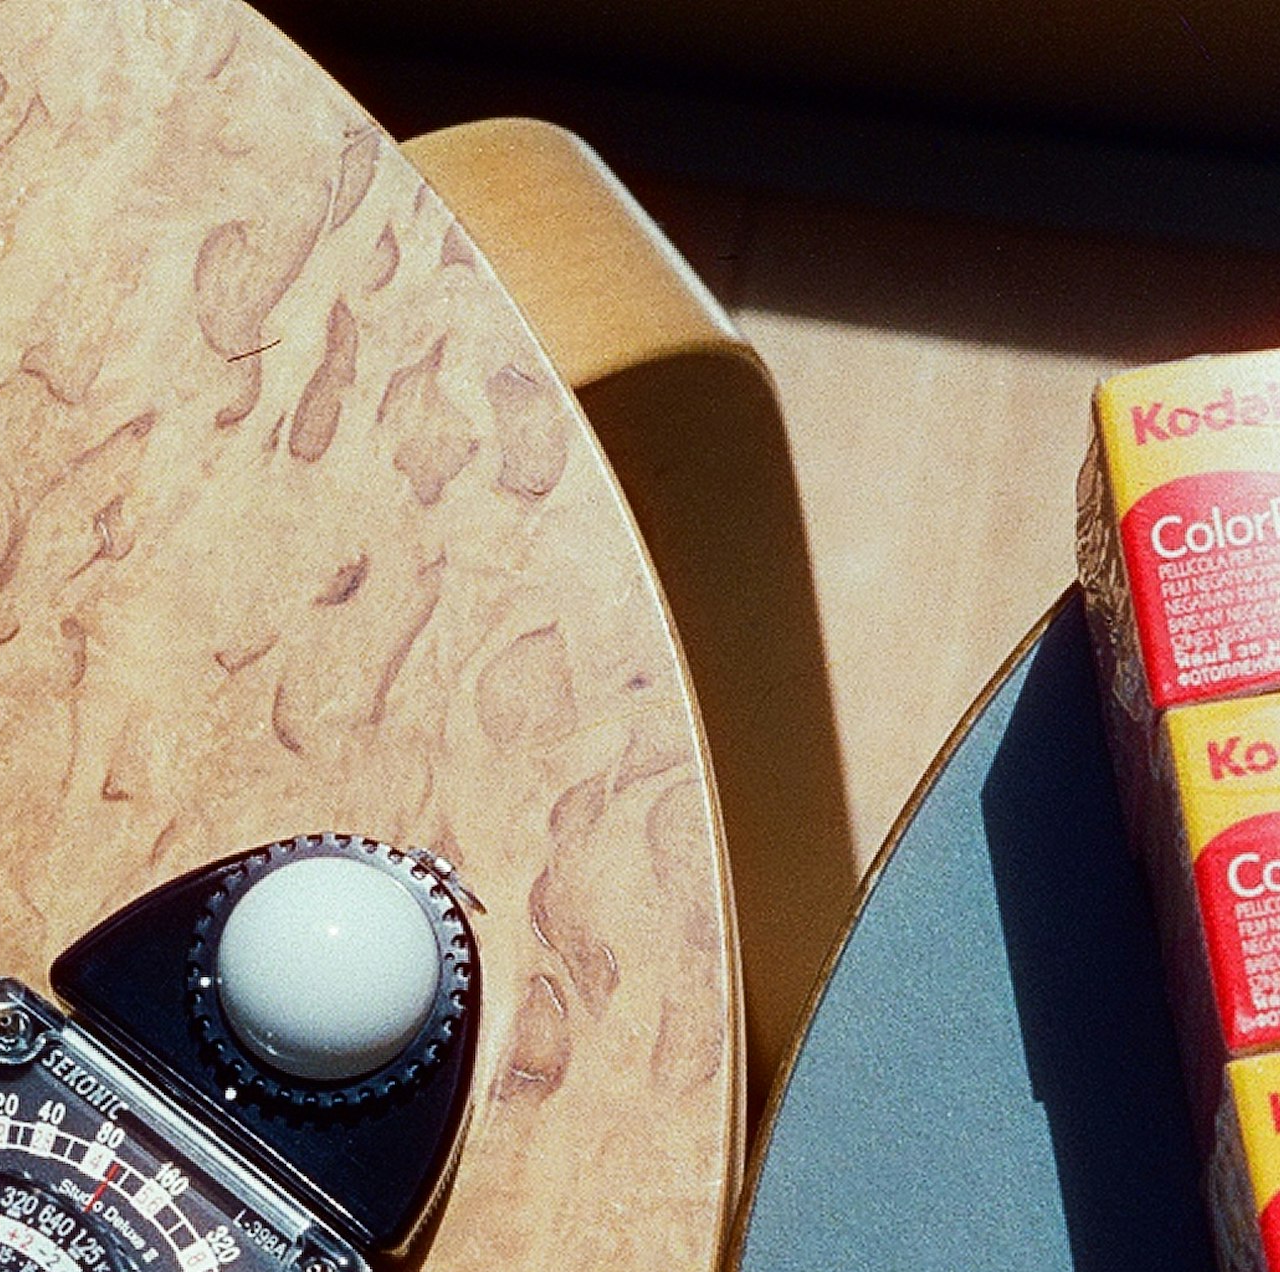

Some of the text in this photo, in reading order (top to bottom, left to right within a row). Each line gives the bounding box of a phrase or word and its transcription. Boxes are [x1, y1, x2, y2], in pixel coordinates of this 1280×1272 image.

[41, 1049, 129, 1120] SEKONIC
[0, 1186, 39, 1215] 320
[38, 1204, 76, 1237] 640
[37, 1099, 66, 1125] 40
[96, 1120, 126, 1149] 80
[154, 1161, 192, 1197] 160
[205, 1225, 241, 1264] 320
[232, 1208, 288, 1265] L-398A
